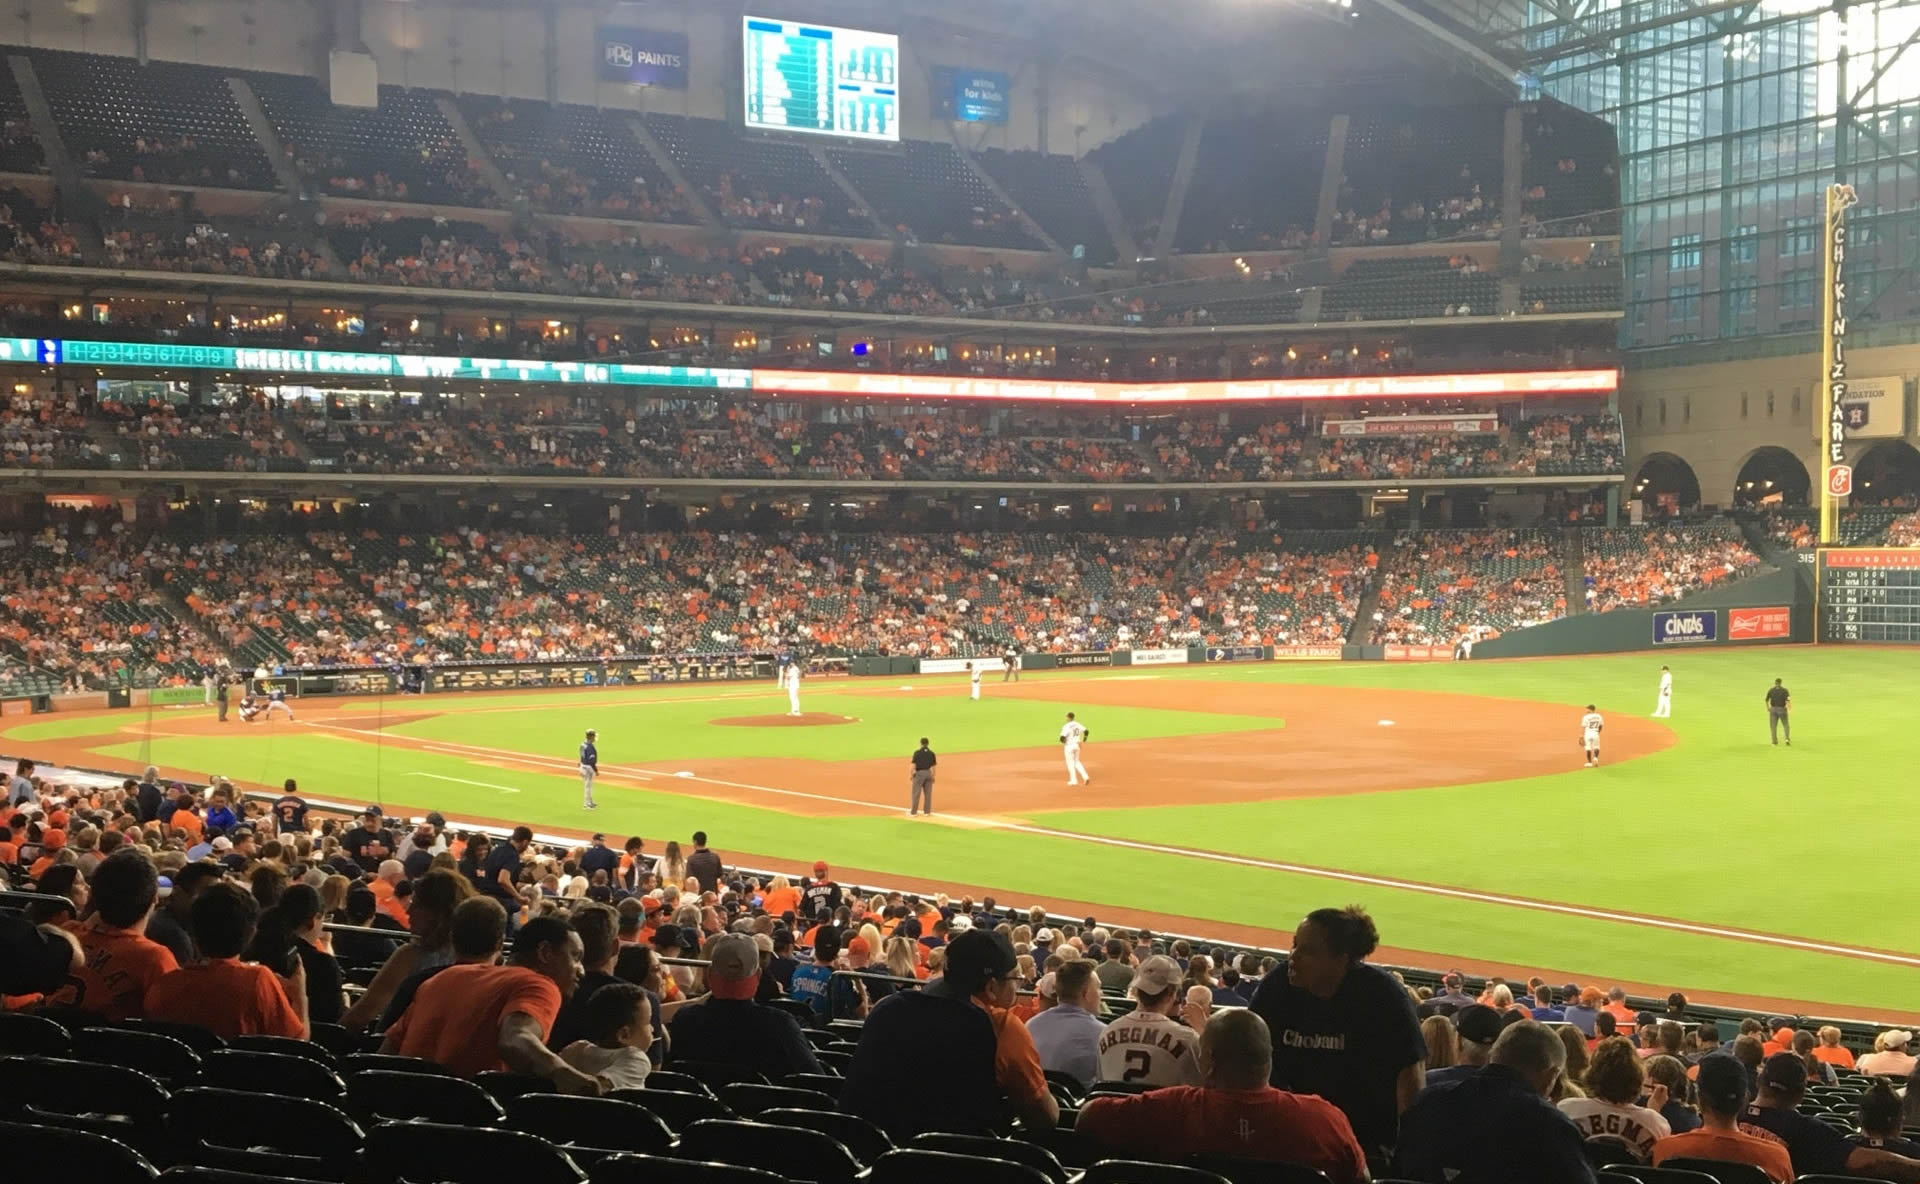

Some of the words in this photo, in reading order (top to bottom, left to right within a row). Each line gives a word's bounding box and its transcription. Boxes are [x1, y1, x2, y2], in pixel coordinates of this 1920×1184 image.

[607, 46, 631, 63] PPG
[637, 51, 680, 67] PAINTS
[964, 88, 978, 98] for
[73, 346, 80, 358] 1
[90, 346, 99, 358] 2
[107, 347, 117, 359] 3
[125, 347, 135, 360] 4
[143, 348, 152, 360] 5
[159, 348, 169, 361] 6
[177, 349, 186, 361] 7
[194, 349, 203, 362] 8
[211, 350, 220, 362] 9
[1846, 390, 1885, 399] NDATION
[1831, 384, 1844, 462] FARE
[1797, 553, 1815, 563] 315
[1065, 656, 1092, 664] CADENCE
[1276, 647, 1308, 656] WELLS
[1310, 647, 1340, 656] FARGO
[1099, 1027, 1187, 1060] BREGMAN
[1282, 1029, 1345, 1050] Chobani
[1123, 1049, 1152, 1081] 2
[1576, 1114, 1658, 1160] EGMA
